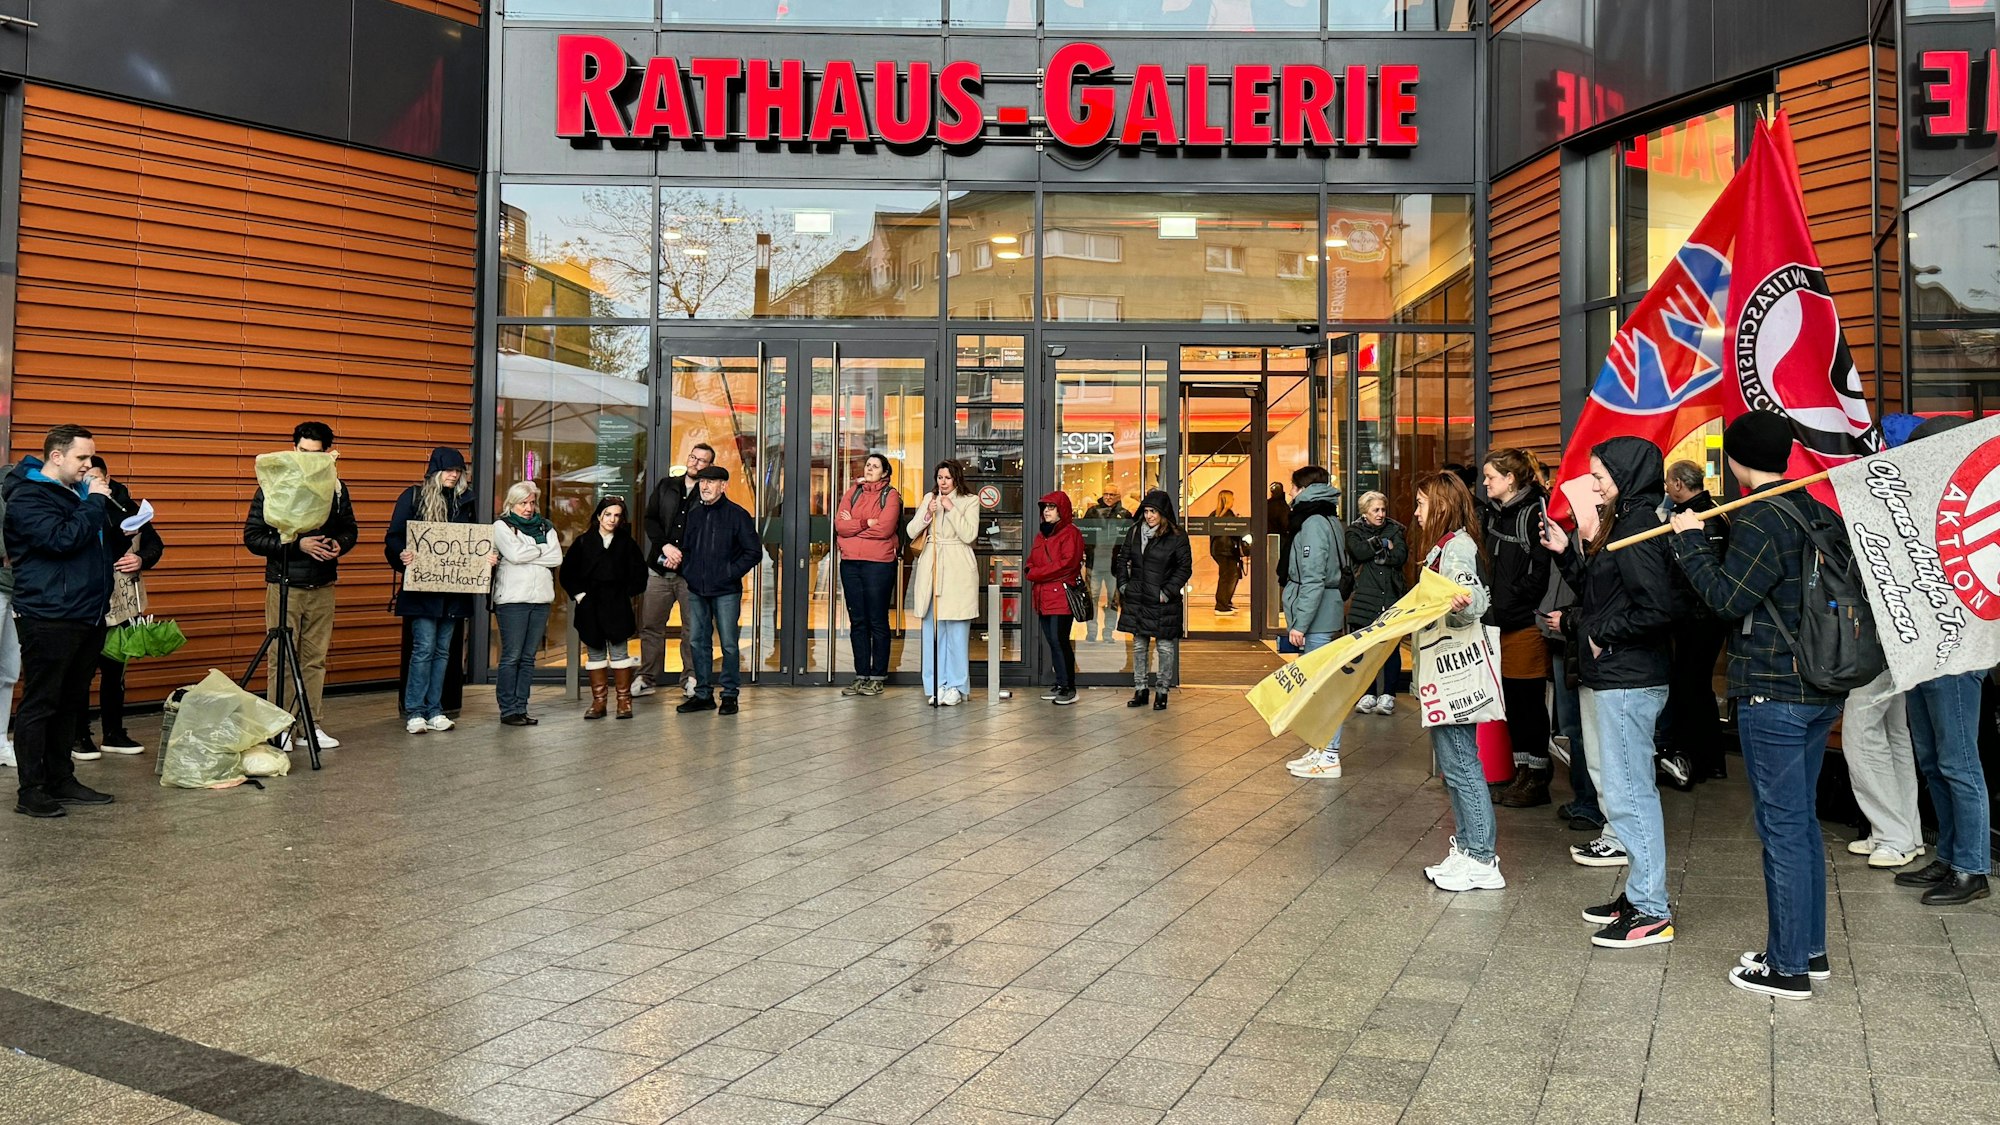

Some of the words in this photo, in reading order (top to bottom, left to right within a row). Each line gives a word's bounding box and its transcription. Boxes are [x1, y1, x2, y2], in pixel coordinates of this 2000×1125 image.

[410, 527, 492, 557] Konto
[1865, 459, 1919, 540] Offenes
[1905, 538, 1955, 609] Antifa
[1938, 482, 1990, 612] AKTION
[412, 566, 490, 587] Bezahlkarte
[439, 556, 468, 568] statt
[1853, 522, 1920, 645] Leverkusen
[1274, 671, 1295, 694] SEN
[1420, 683, 1447, 723] 913
